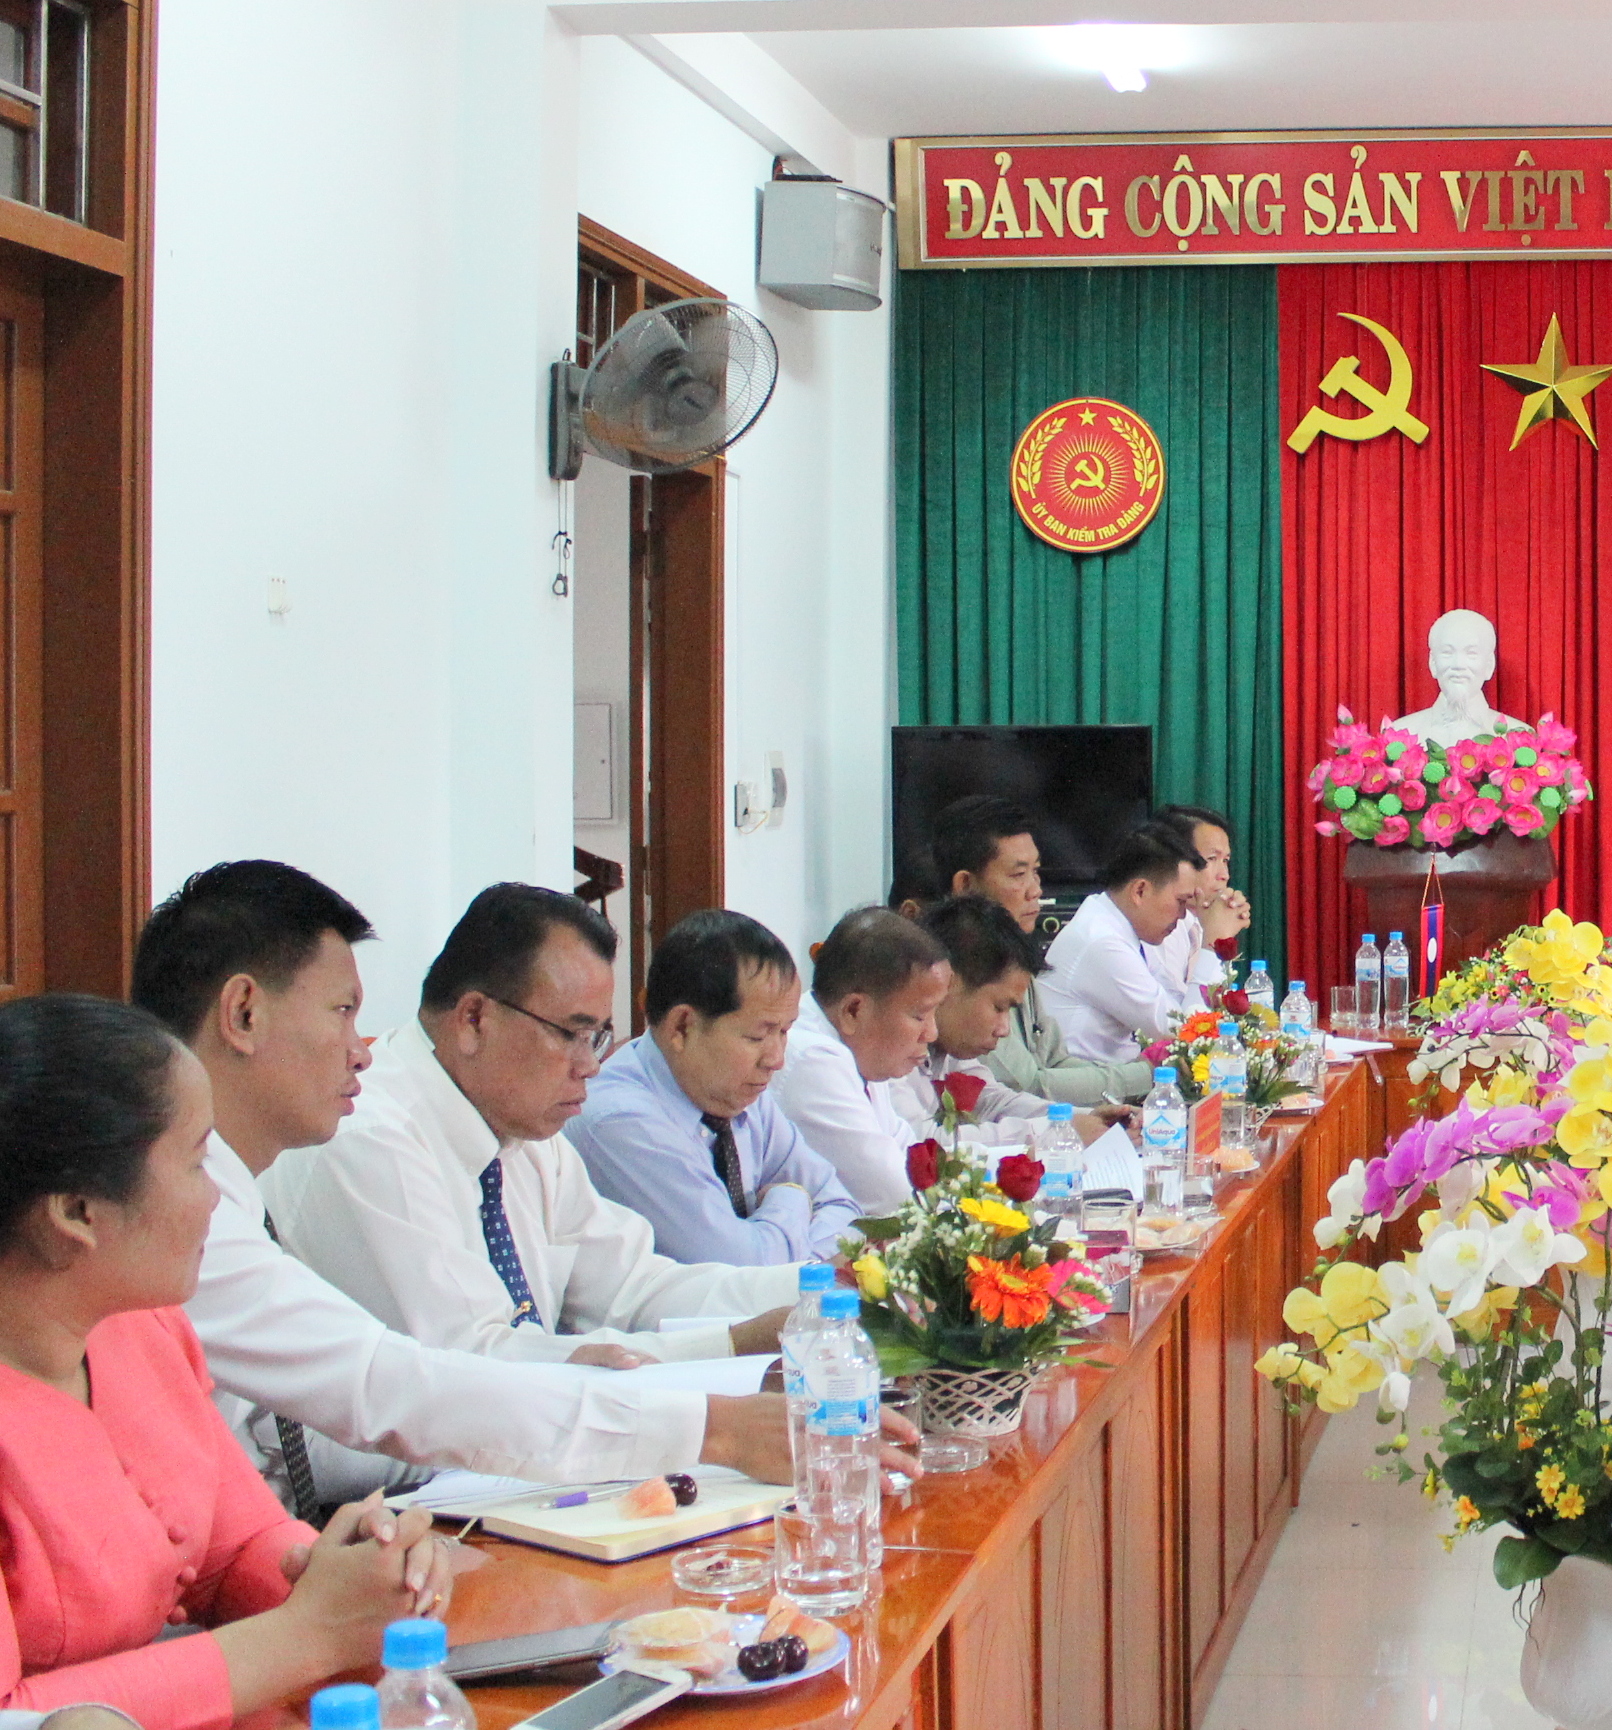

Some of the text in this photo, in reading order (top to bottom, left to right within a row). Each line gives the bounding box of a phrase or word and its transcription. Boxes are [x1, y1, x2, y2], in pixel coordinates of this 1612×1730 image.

[943, 151, 1109, 239] ĐẢNG
[1124, 154, 1287, 252] CỘNG
[1303, 145, 1422, 236] SẢN
[1440, 150, 1585, 246] VIỆT
[1032, 502, 1145, 542] ỦY BAN KIỂM TRA ĐẢNG
